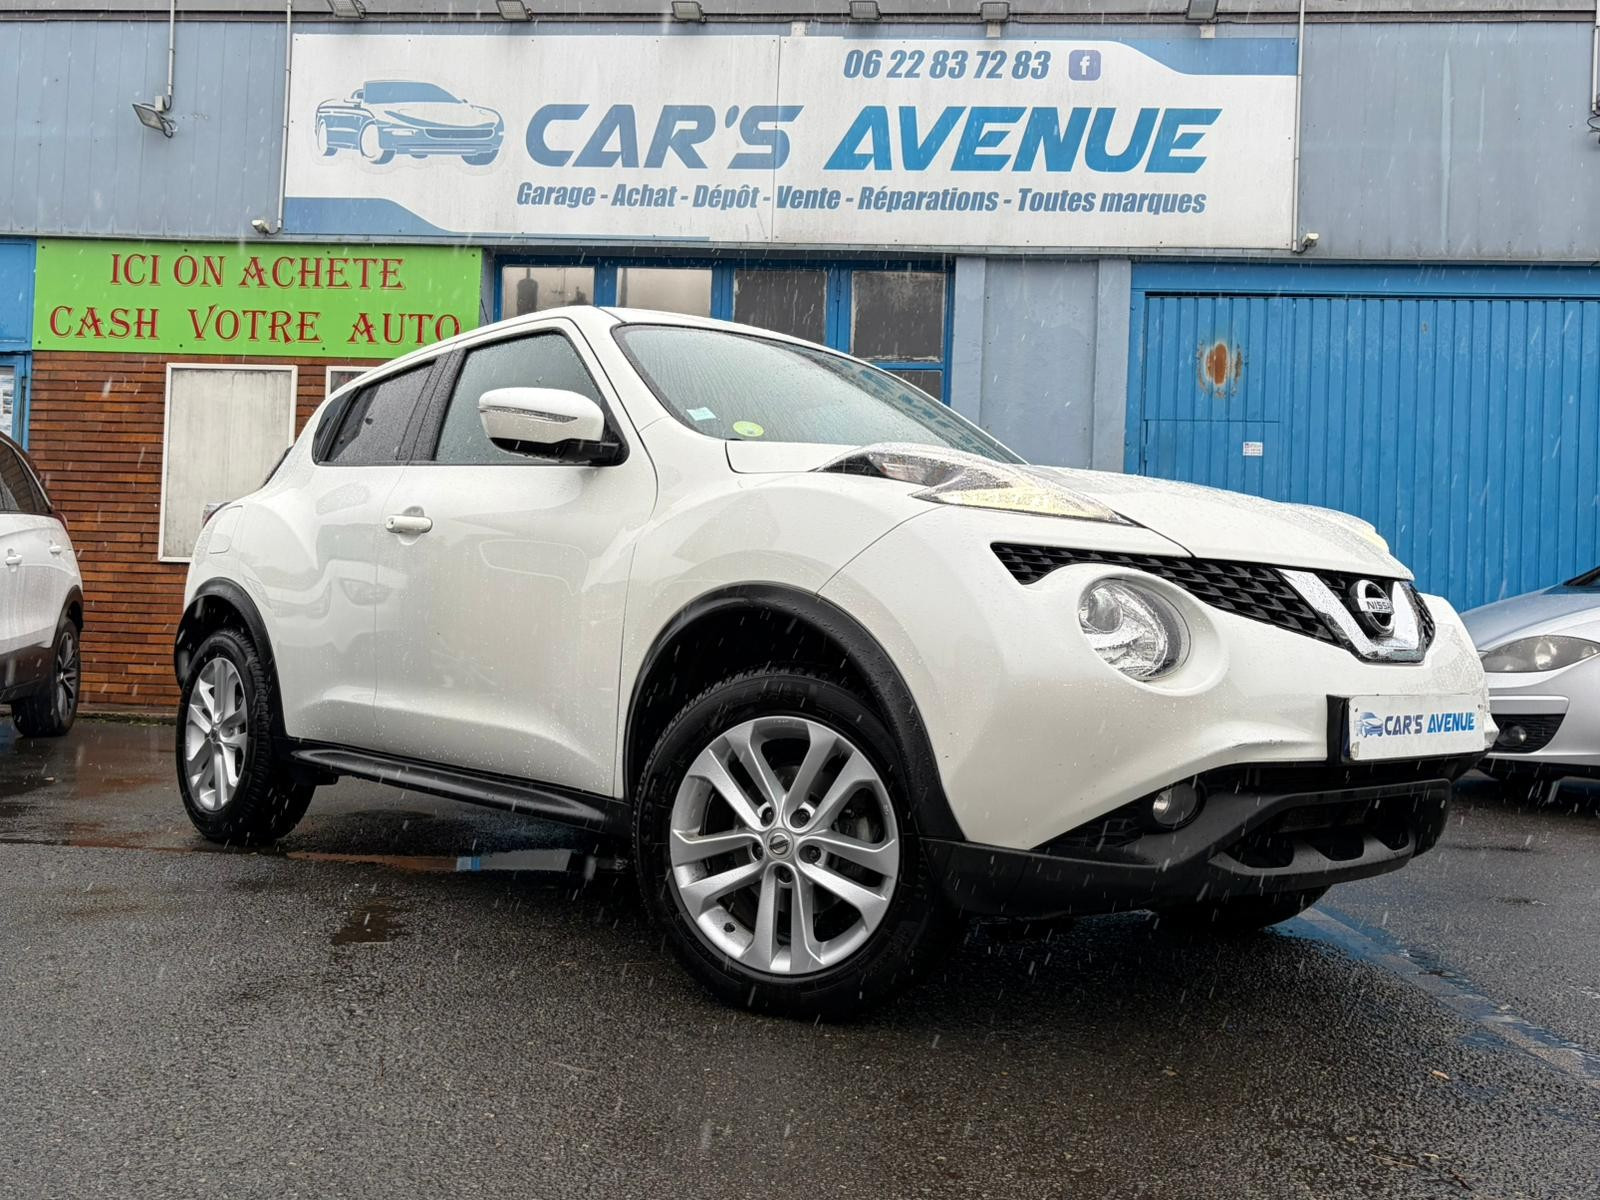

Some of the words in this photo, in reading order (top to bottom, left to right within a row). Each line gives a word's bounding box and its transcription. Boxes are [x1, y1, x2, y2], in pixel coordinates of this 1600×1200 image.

[843, 49, 883, 80] 06
[886, 50, 927, 80] 22
[929, 50, 967, 80] 83
[973, 50, 1009, 80] 72
[1011, 50, 1051, 80] 83
[525, 103, 804, 171] CAR'S
[823, 105, 1223, 174] AVENUE
[516, 182, 596, 209] Garage
[611, 184, 678, 208] Achat
[692, 184, 760, 210] Dépôt
[776, 186, 841, 209] Vente
[857, 185, 999, 213] Réparations
[1017, 188, 1096, 212] Toutes
[1099, 192, 1207, 216] marques
[110, 254, 160, 285] ICI
[173, 255, 226, 287] ON
[239, 256, 406, 290] ACHETE
[49, 306, 160, 341] CASH
[187, 304, 323, 344] VOTRE
[346, 312, 462, 345] AUTO
[1384, 714, 1424, 736] CAR'S
[1427, 712, 1476, 733] AVENUE
